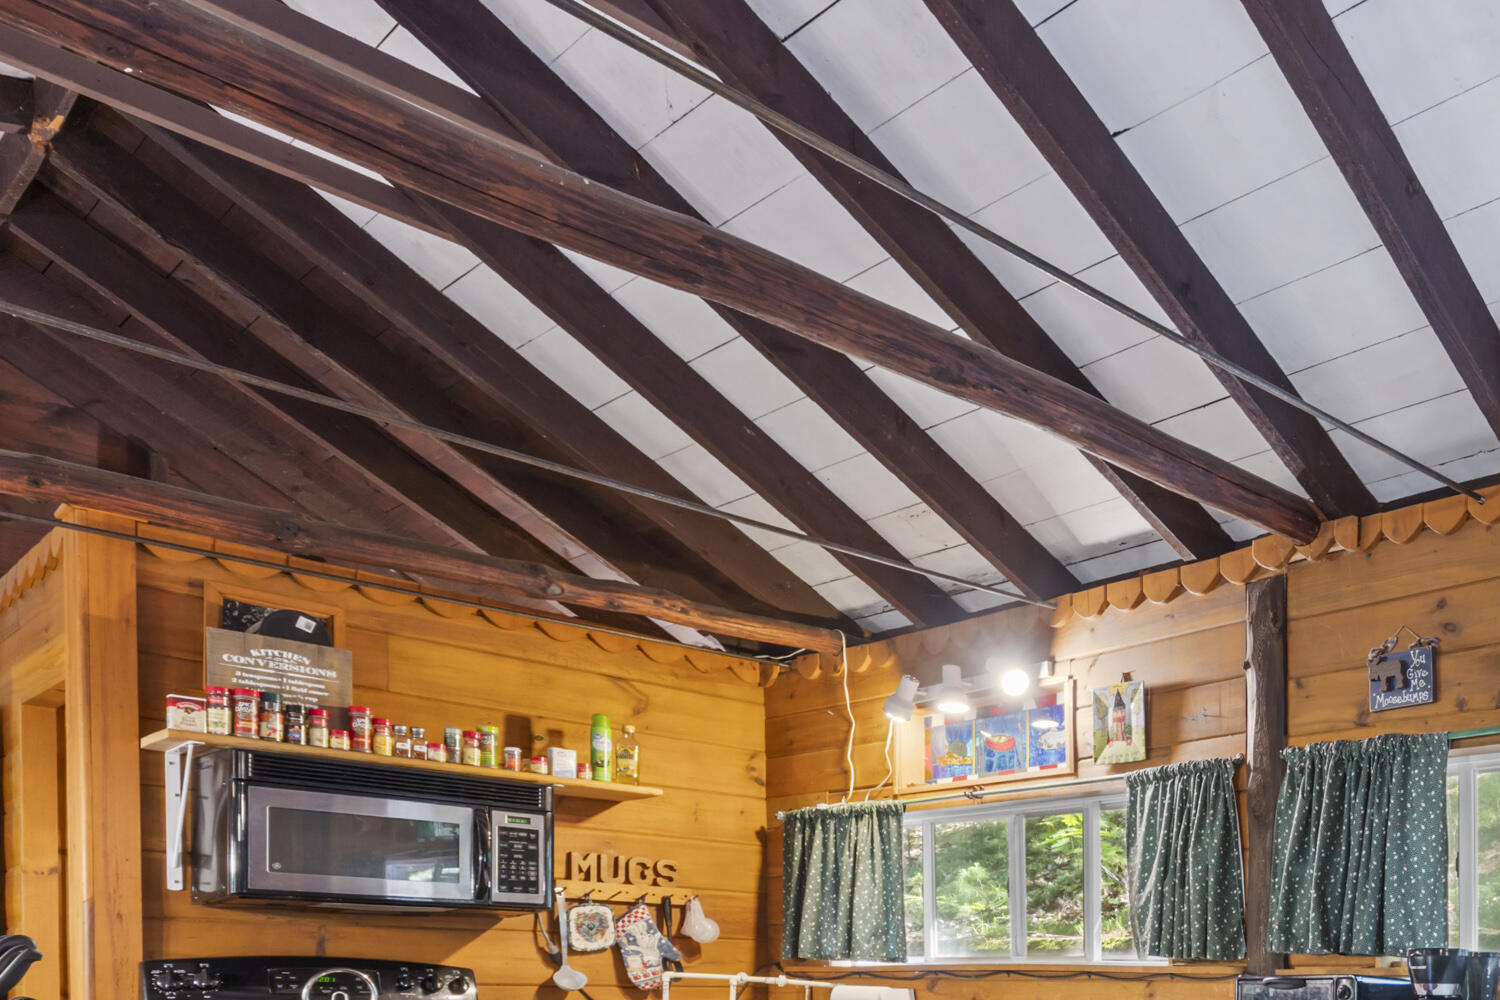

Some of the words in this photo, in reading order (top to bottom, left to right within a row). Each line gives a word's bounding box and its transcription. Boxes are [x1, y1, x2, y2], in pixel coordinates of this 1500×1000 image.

[222, 653, 337, 678] CONVERSIONS
[250, 649, 311, 665] KITCHEN
[1410, 650, 1426, 668] You
[1407, 668, 1428, 679] Give
[1410, 679, 1425, 691] Me
[1375, 691, 1428, 708] Moosebumps
[570, 851, 680, 887] MUGS
